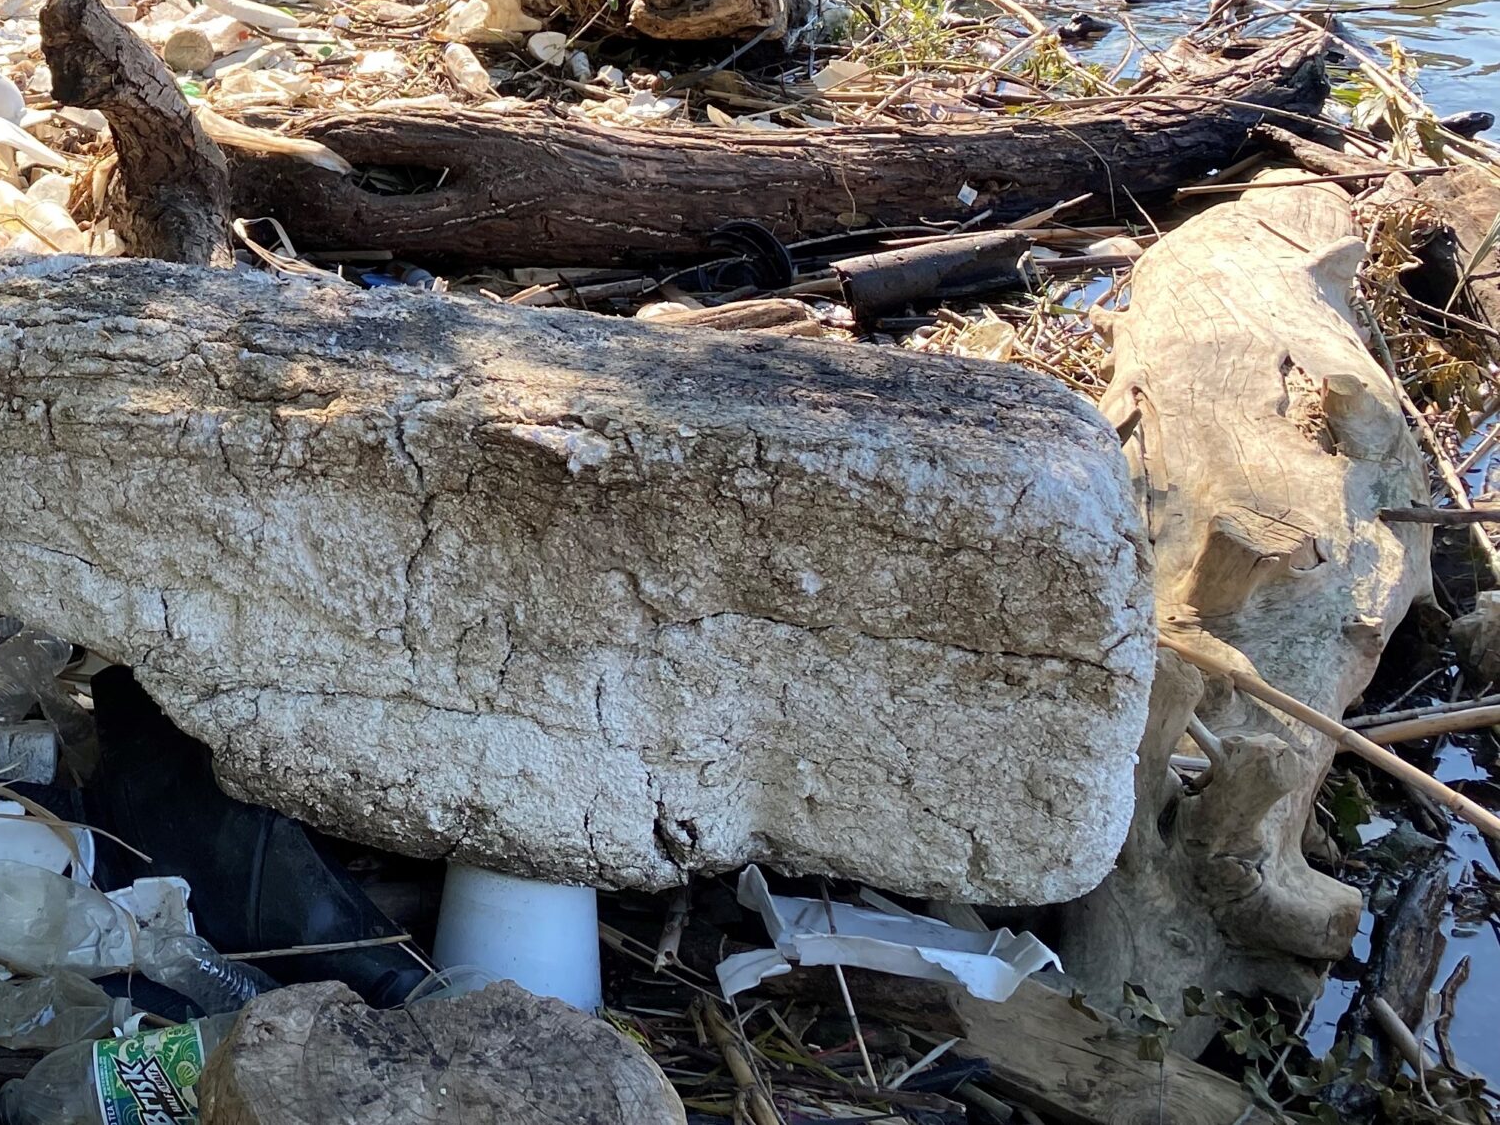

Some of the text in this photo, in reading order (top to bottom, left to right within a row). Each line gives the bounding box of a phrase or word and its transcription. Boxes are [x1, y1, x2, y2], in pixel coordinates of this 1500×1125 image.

[148, 1068, 168, 1089] HALF
[163, 1093, 183, 1113] HALF
[107, 1106, 116, 1122] TEA
